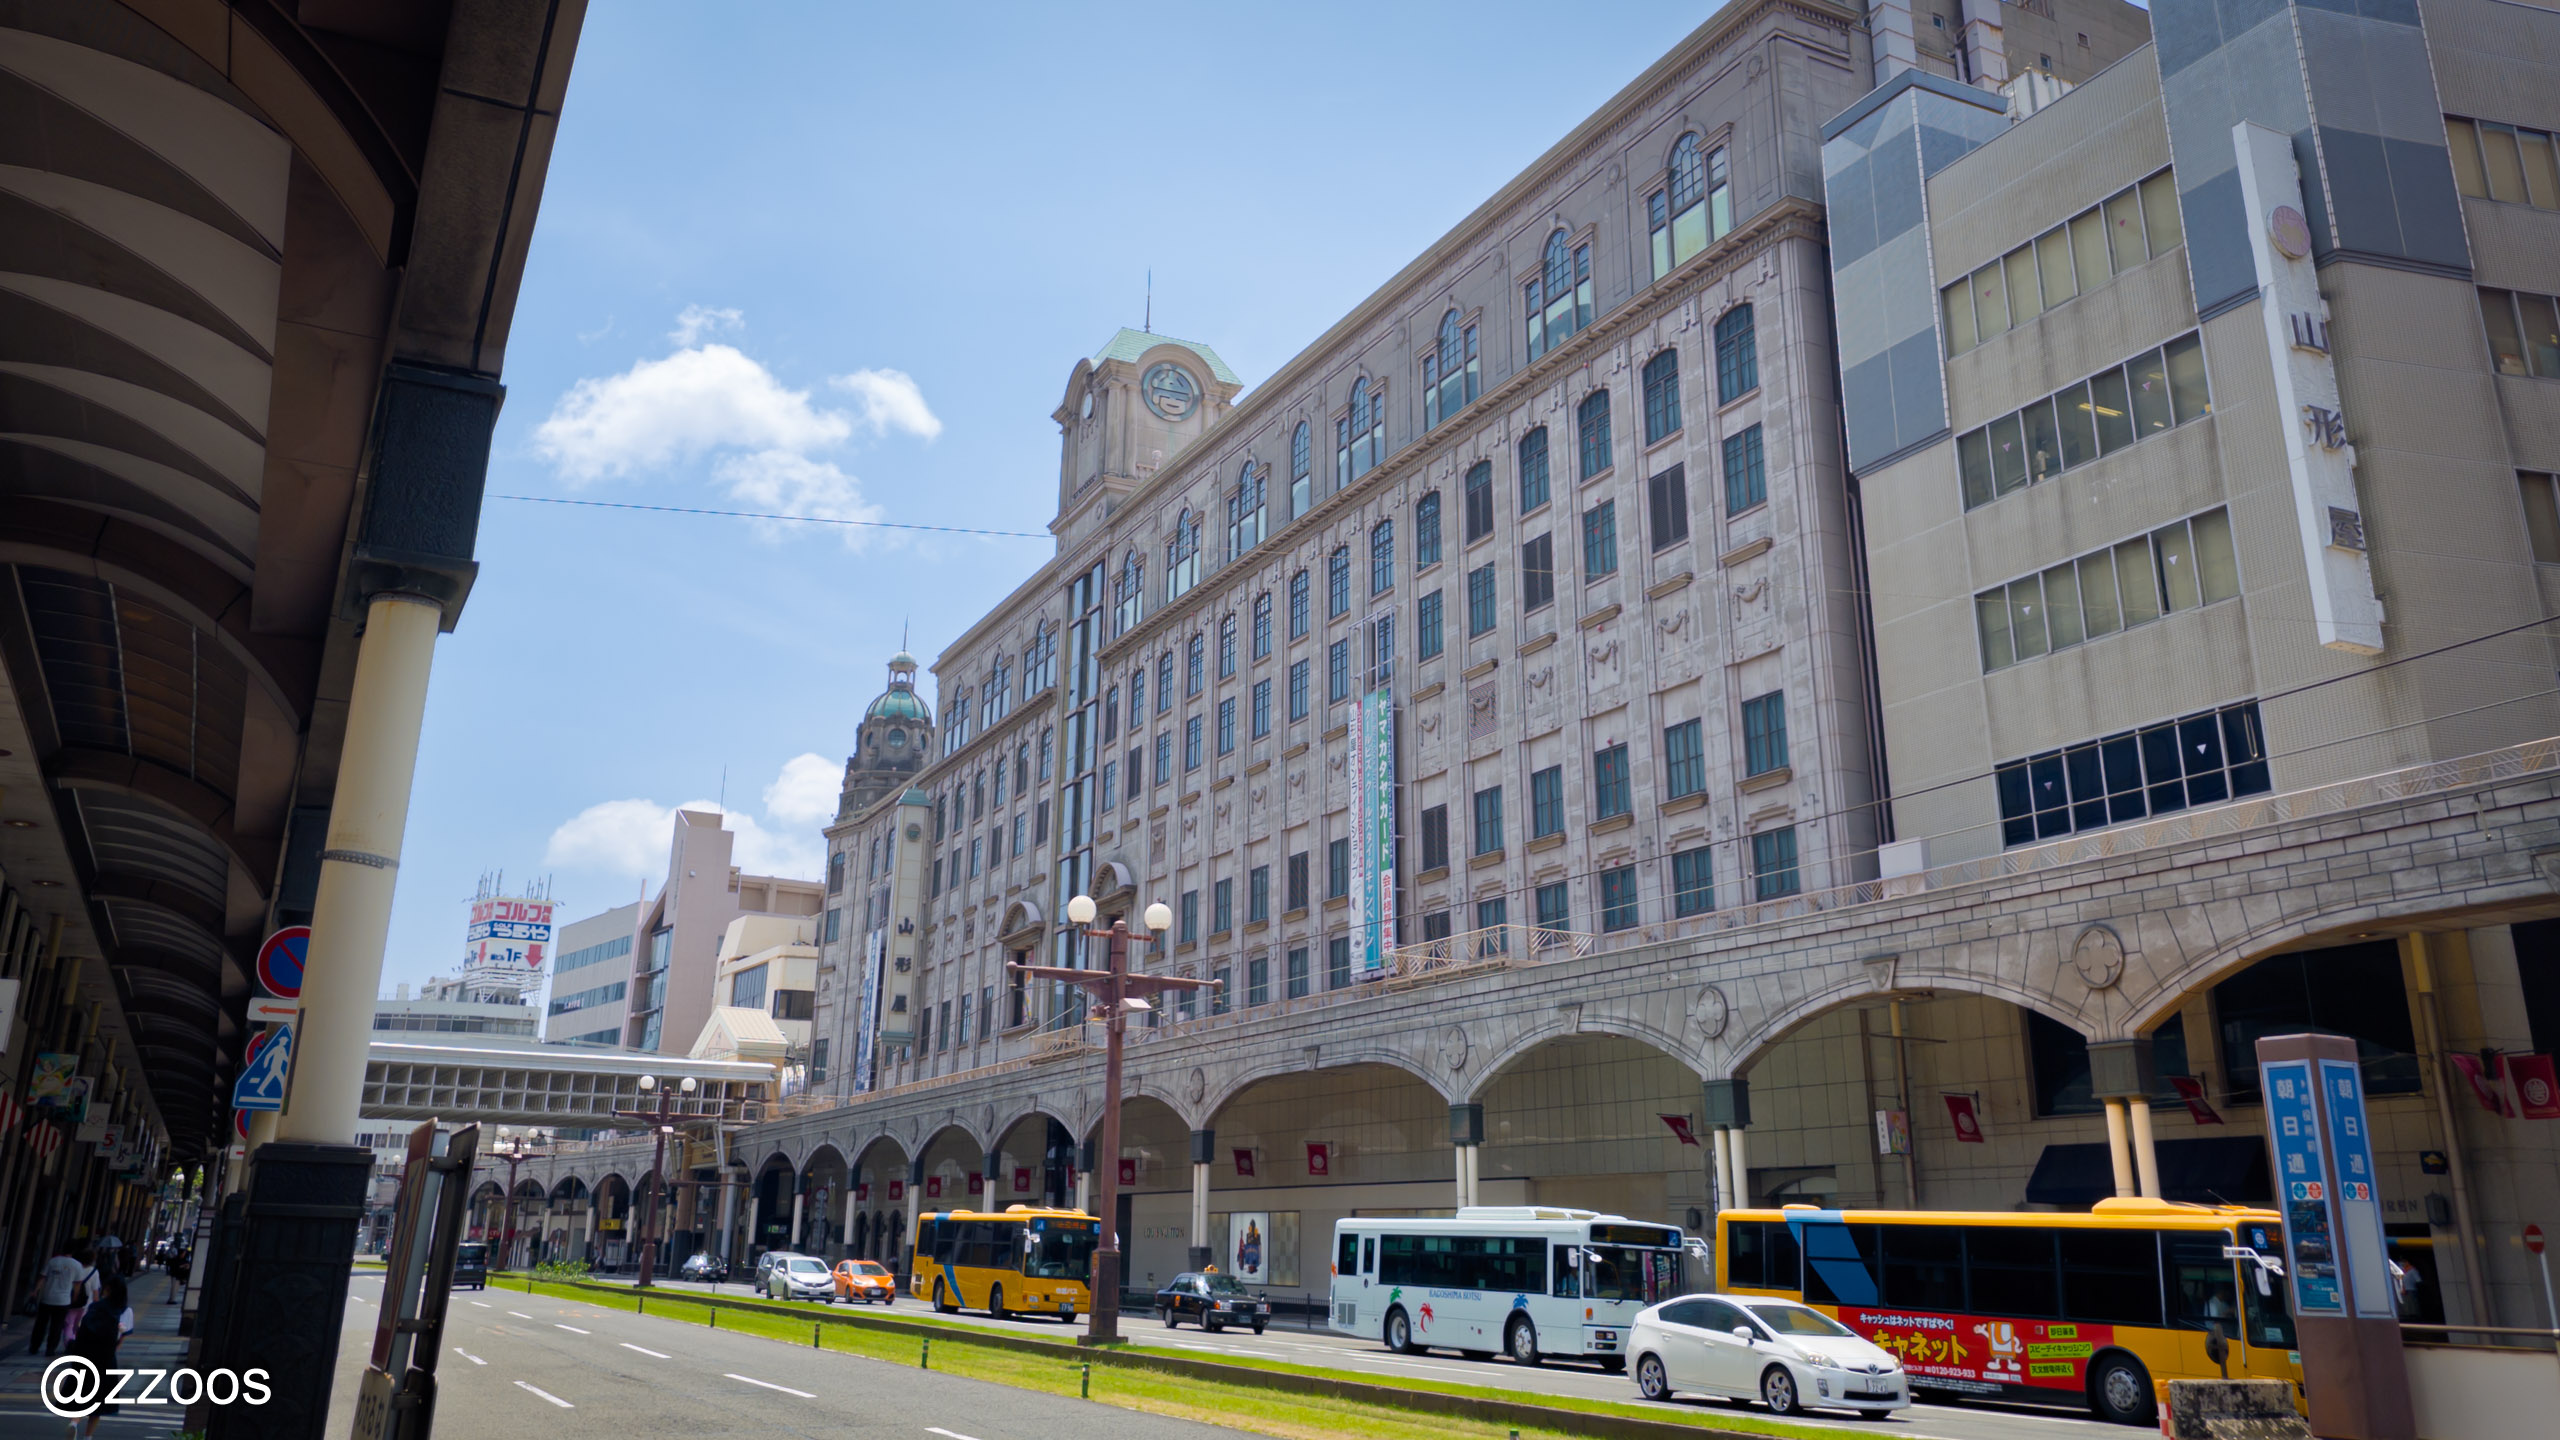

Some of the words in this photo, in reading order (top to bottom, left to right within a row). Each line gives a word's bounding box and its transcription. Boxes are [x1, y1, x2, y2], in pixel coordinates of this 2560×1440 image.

[2291, 311, 2366, 554] 山形屋
[1379, 699, 1389, 861] ヤマカタヤカード
[493, 925, 549, 940] つるや
[495, 901, 542, 923] ゴルフ
[1383, 874, 1392, 951] 会員様募集中
[891, 917, 914, 1013] 山形屋
[2276, 1078, 2306, 1174] 朝日通
[2338, 1078, 2365, 1174] 朝日通
[1873, 1329, 1968, 1365] キャネット
